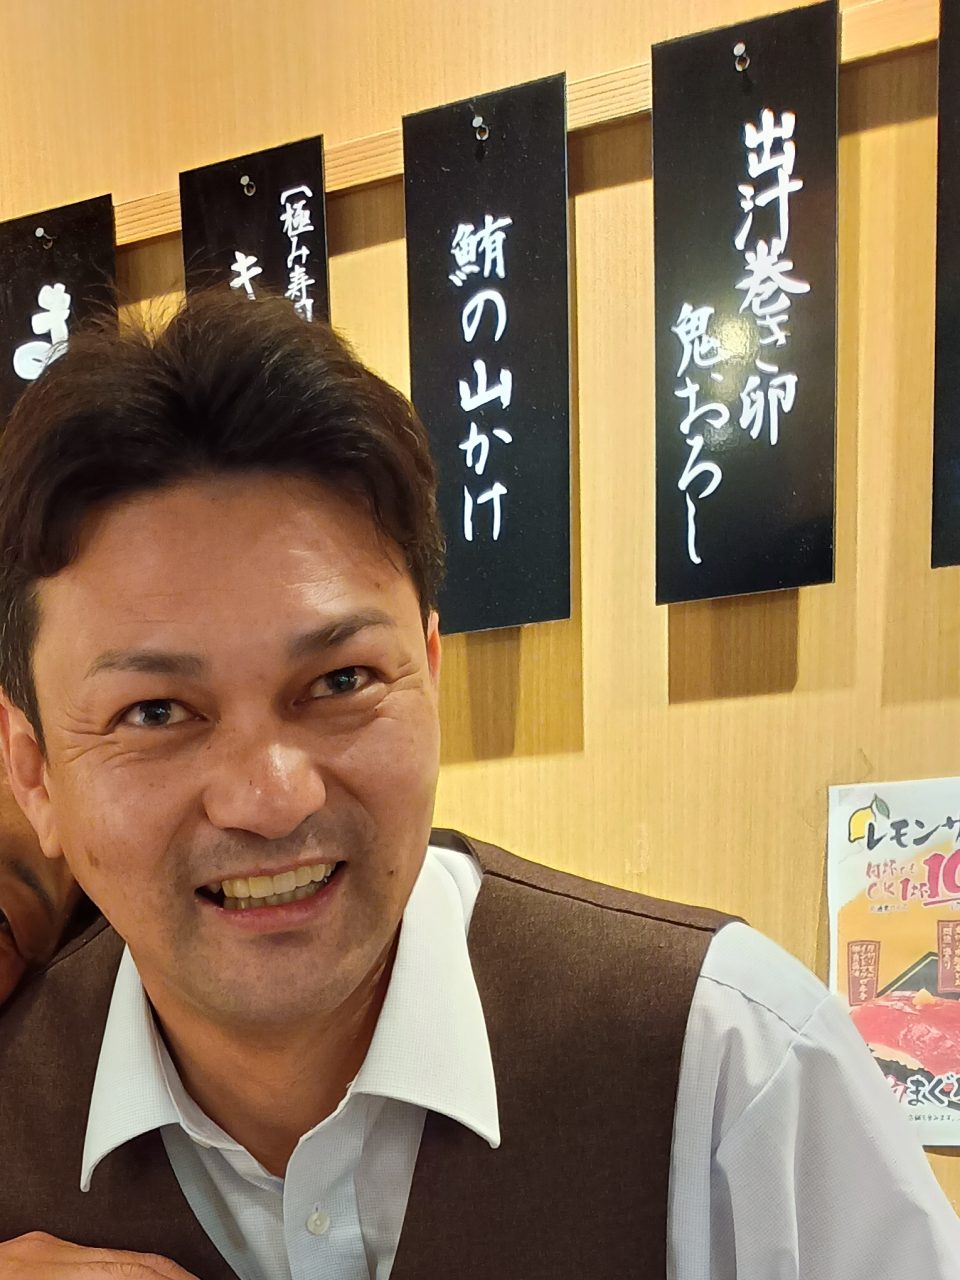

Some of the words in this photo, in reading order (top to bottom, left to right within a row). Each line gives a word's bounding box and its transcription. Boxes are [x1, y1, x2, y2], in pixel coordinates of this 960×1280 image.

[448, 214, 513, 542] 鮪の山かけ
[670, 302, 731, 565] 鬼おろし
[734, 108, 811, 446] 出汁巻き卵
